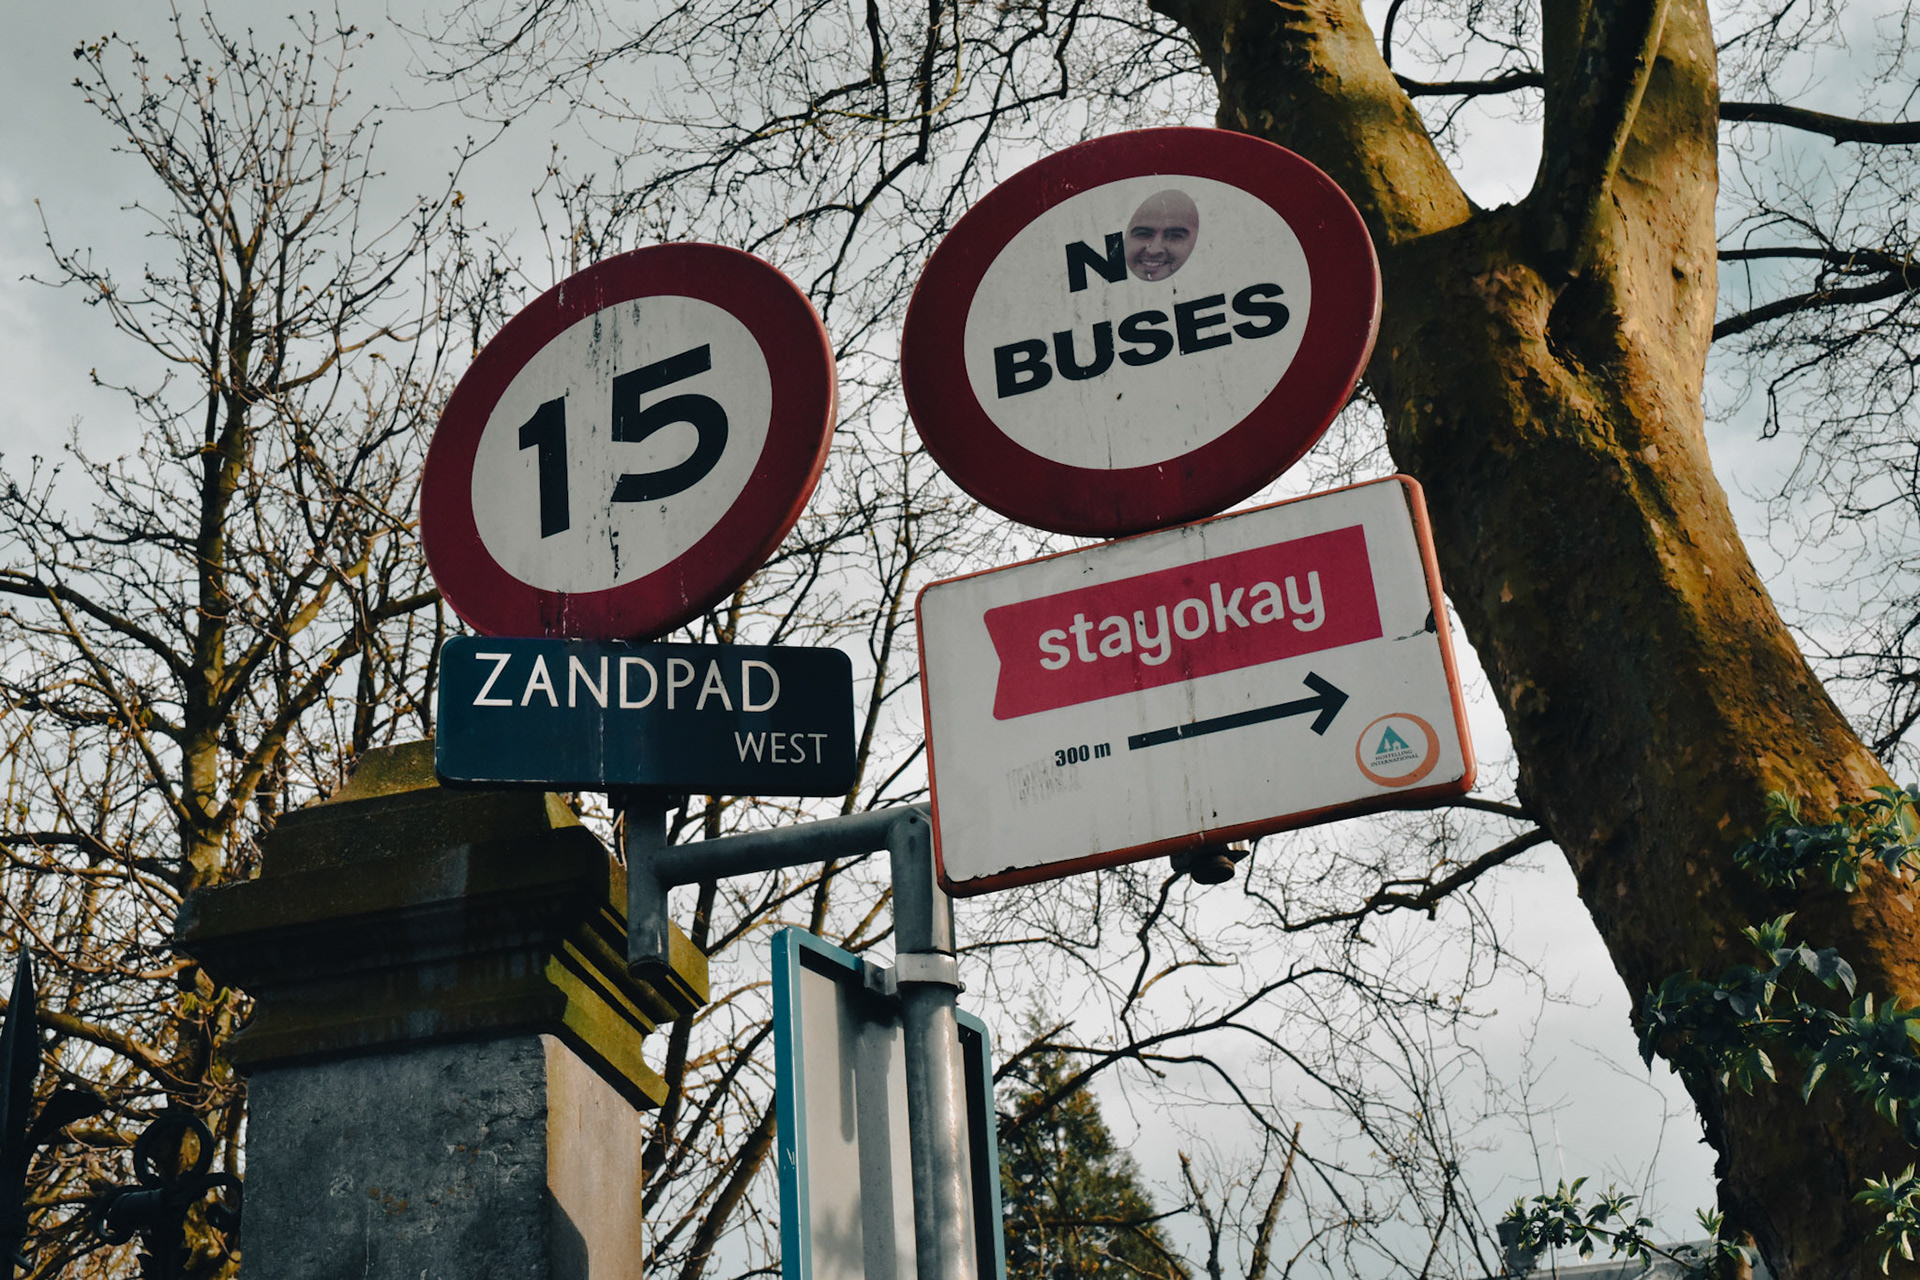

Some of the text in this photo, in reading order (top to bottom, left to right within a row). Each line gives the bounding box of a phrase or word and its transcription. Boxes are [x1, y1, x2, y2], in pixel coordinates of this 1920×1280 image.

[994, 283, 1290, 399] BUSES
[518, 343, 729, 539] 15
[1038, 570, 1326, 671] stayokay
[473, 652, 780, 712] ZANDPAD
[734, 731, 828, 764] WEST
[1054, 742, 1111, 767] 300 m
[1370, 753, 1419, 767] INTERNATIONAL
[1375, 749, 1413, 761] HOSTELLING
